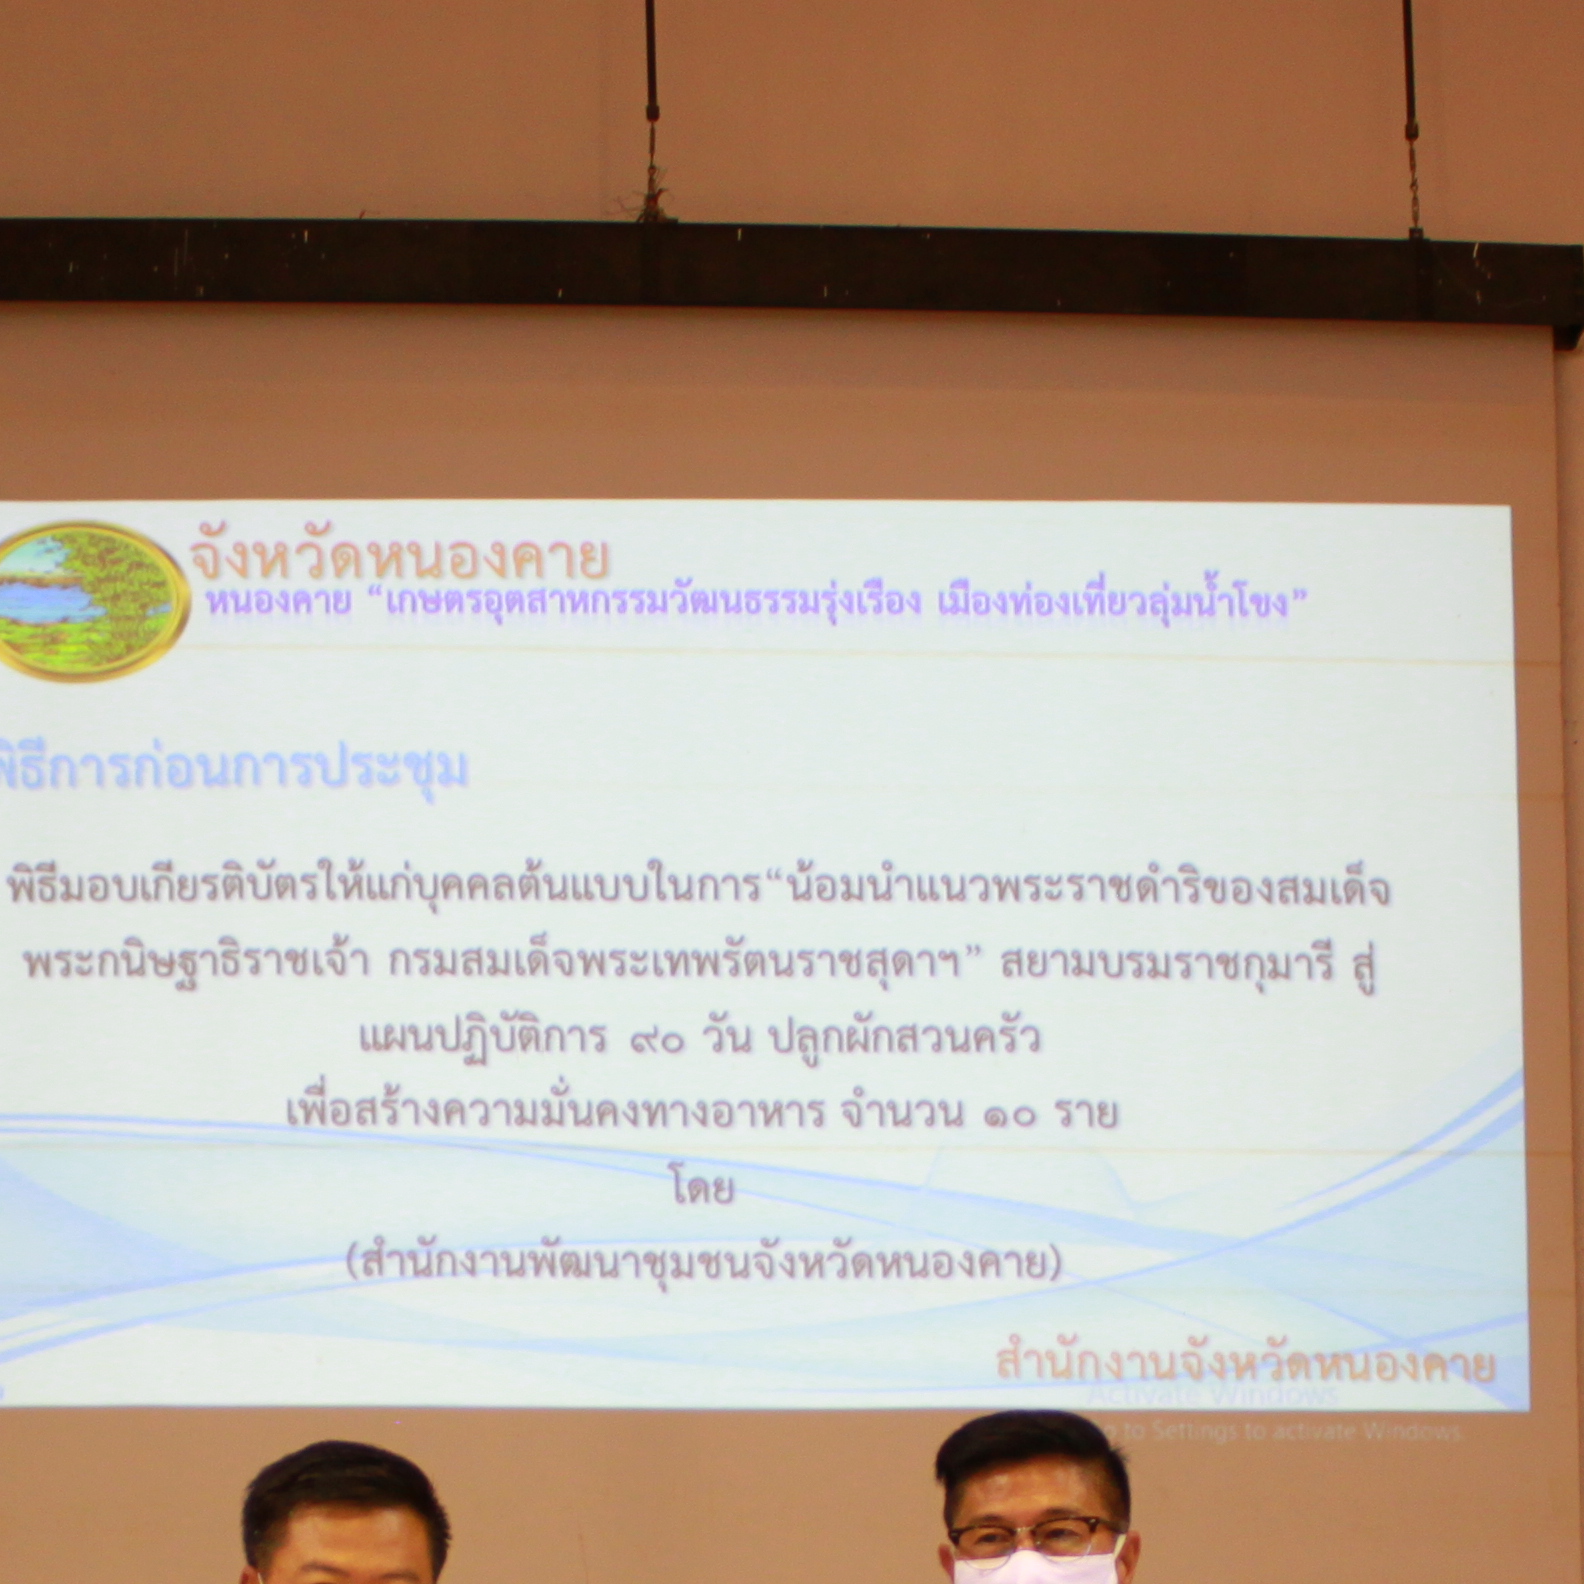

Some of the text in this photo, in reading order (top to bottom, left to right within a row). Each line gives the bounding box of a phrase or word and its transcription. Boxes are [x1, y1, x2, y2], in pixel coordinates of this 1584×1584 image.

[190, 519, 612, 582] จังหวัดหนองคาย
[204, 586, 352, 619] หนองคาย
[22, 932, 1376, 997] พระกนิษฐาธิราชเจ้า กรมสมเด็จพระเทพรัตนราชสุดาฯ” สยามบรมราชกุมารี สู่
[359, 1010, 1044, 1069] แผนปฏิบัติการ ๙๐ วัน ปลูกผักสวนครัว
[286, 1074, 1120, 1130] เพื่อสร้างความมั่นคงทางอาหาร จำนวน ๑๐ ราย
[667, 1161, 736, 1206] โดย
[345, 1238, 1064, 1293] (สำนักงานพัฒนาชุมชนจังหวัดหนองคาย)
[995, 1333, 1497, 1383] สำนักงานจังหวัดหนองคาย
[1087, 1382, 1339, 1407] Activate Windows
